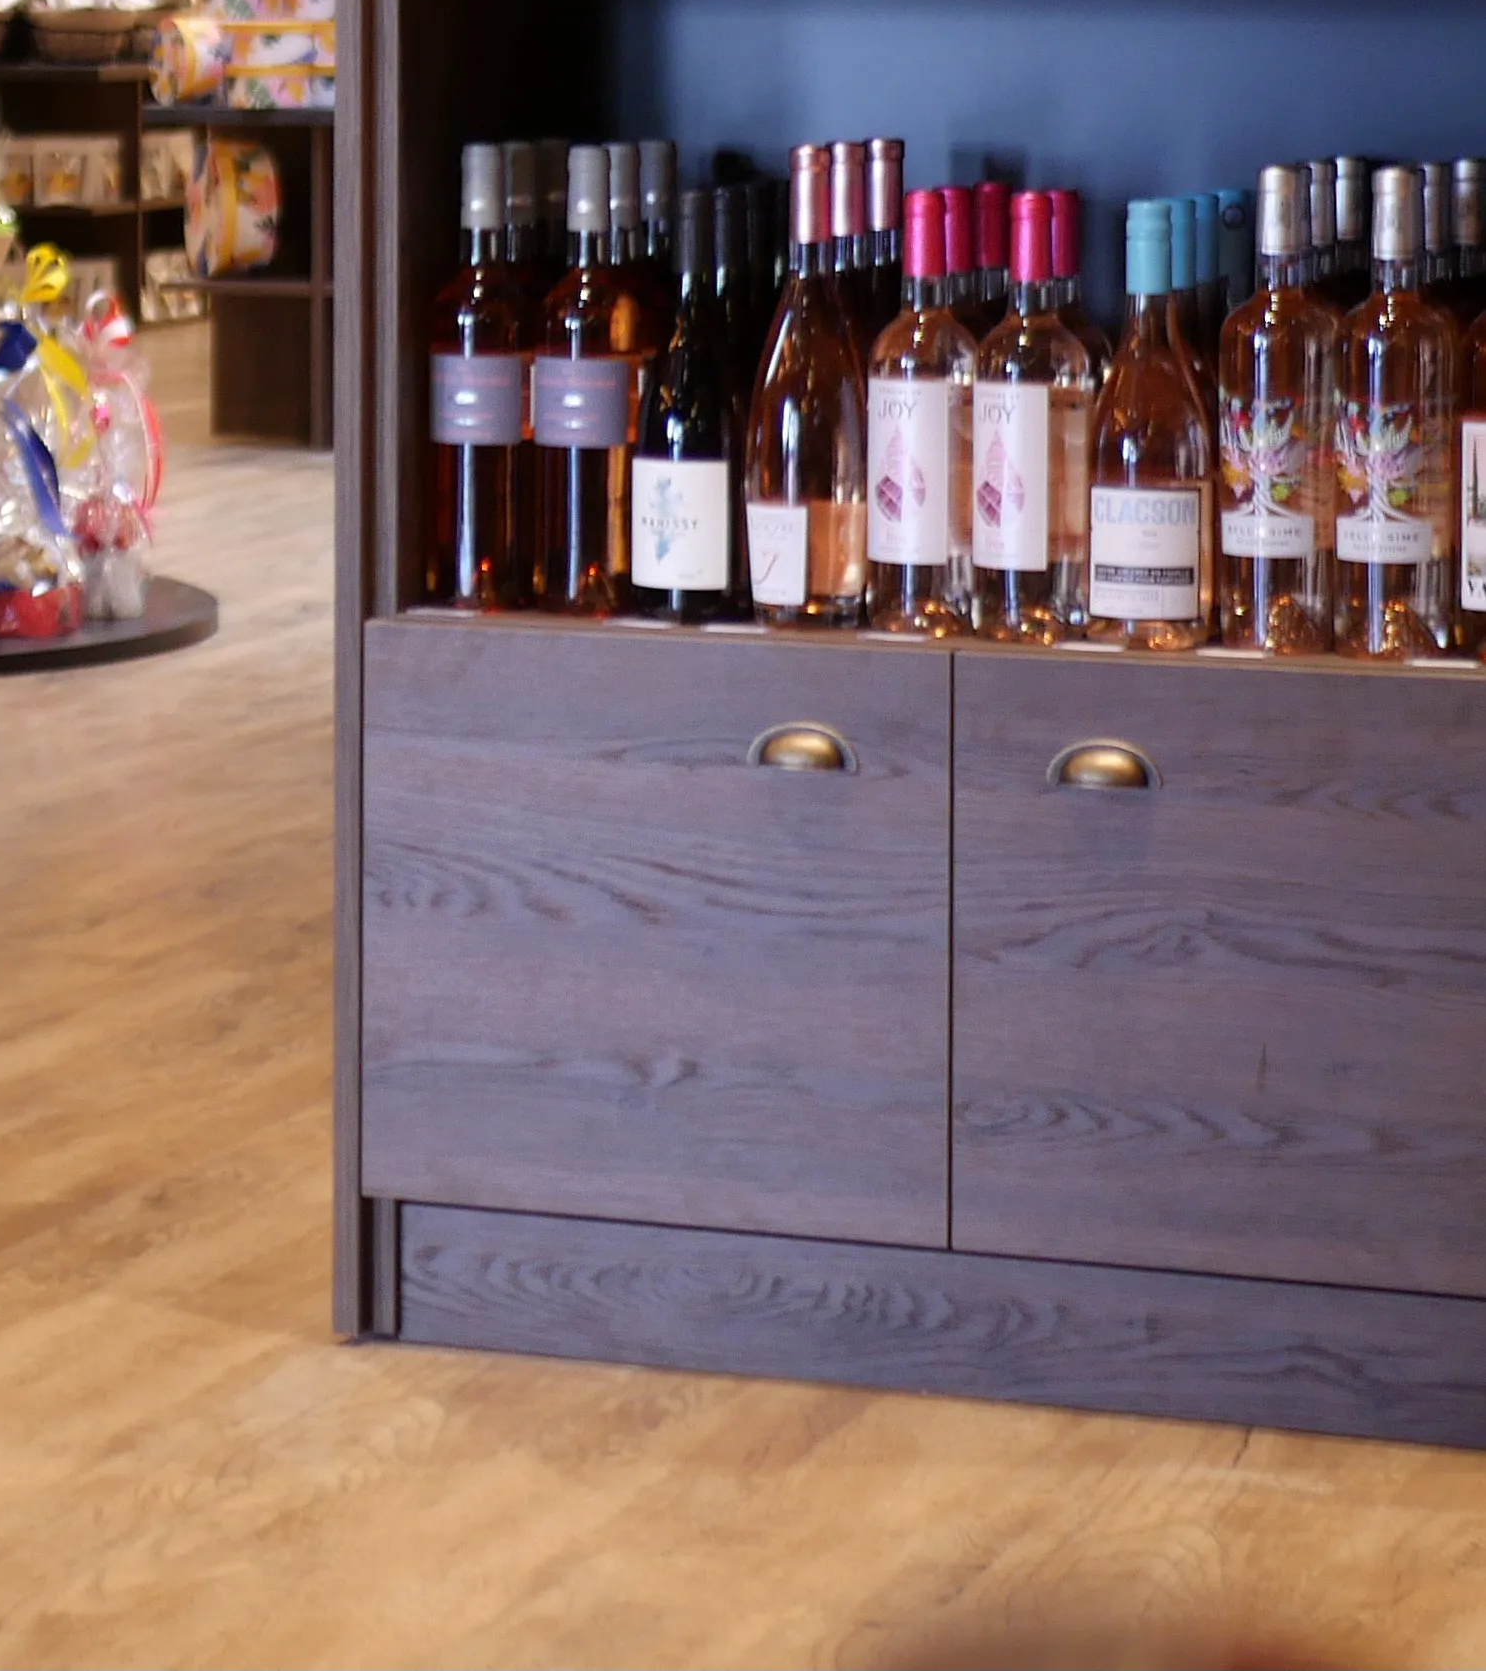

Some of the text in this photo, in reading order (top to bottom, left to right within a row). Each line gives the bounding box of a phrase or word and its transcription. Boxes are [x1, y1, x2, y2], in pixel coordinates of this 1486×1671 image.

[878, 399, 917, 420] JOY
[980, 402, 1015, 424] JOY
[1094, 495, 1197, 526] CLACSON
